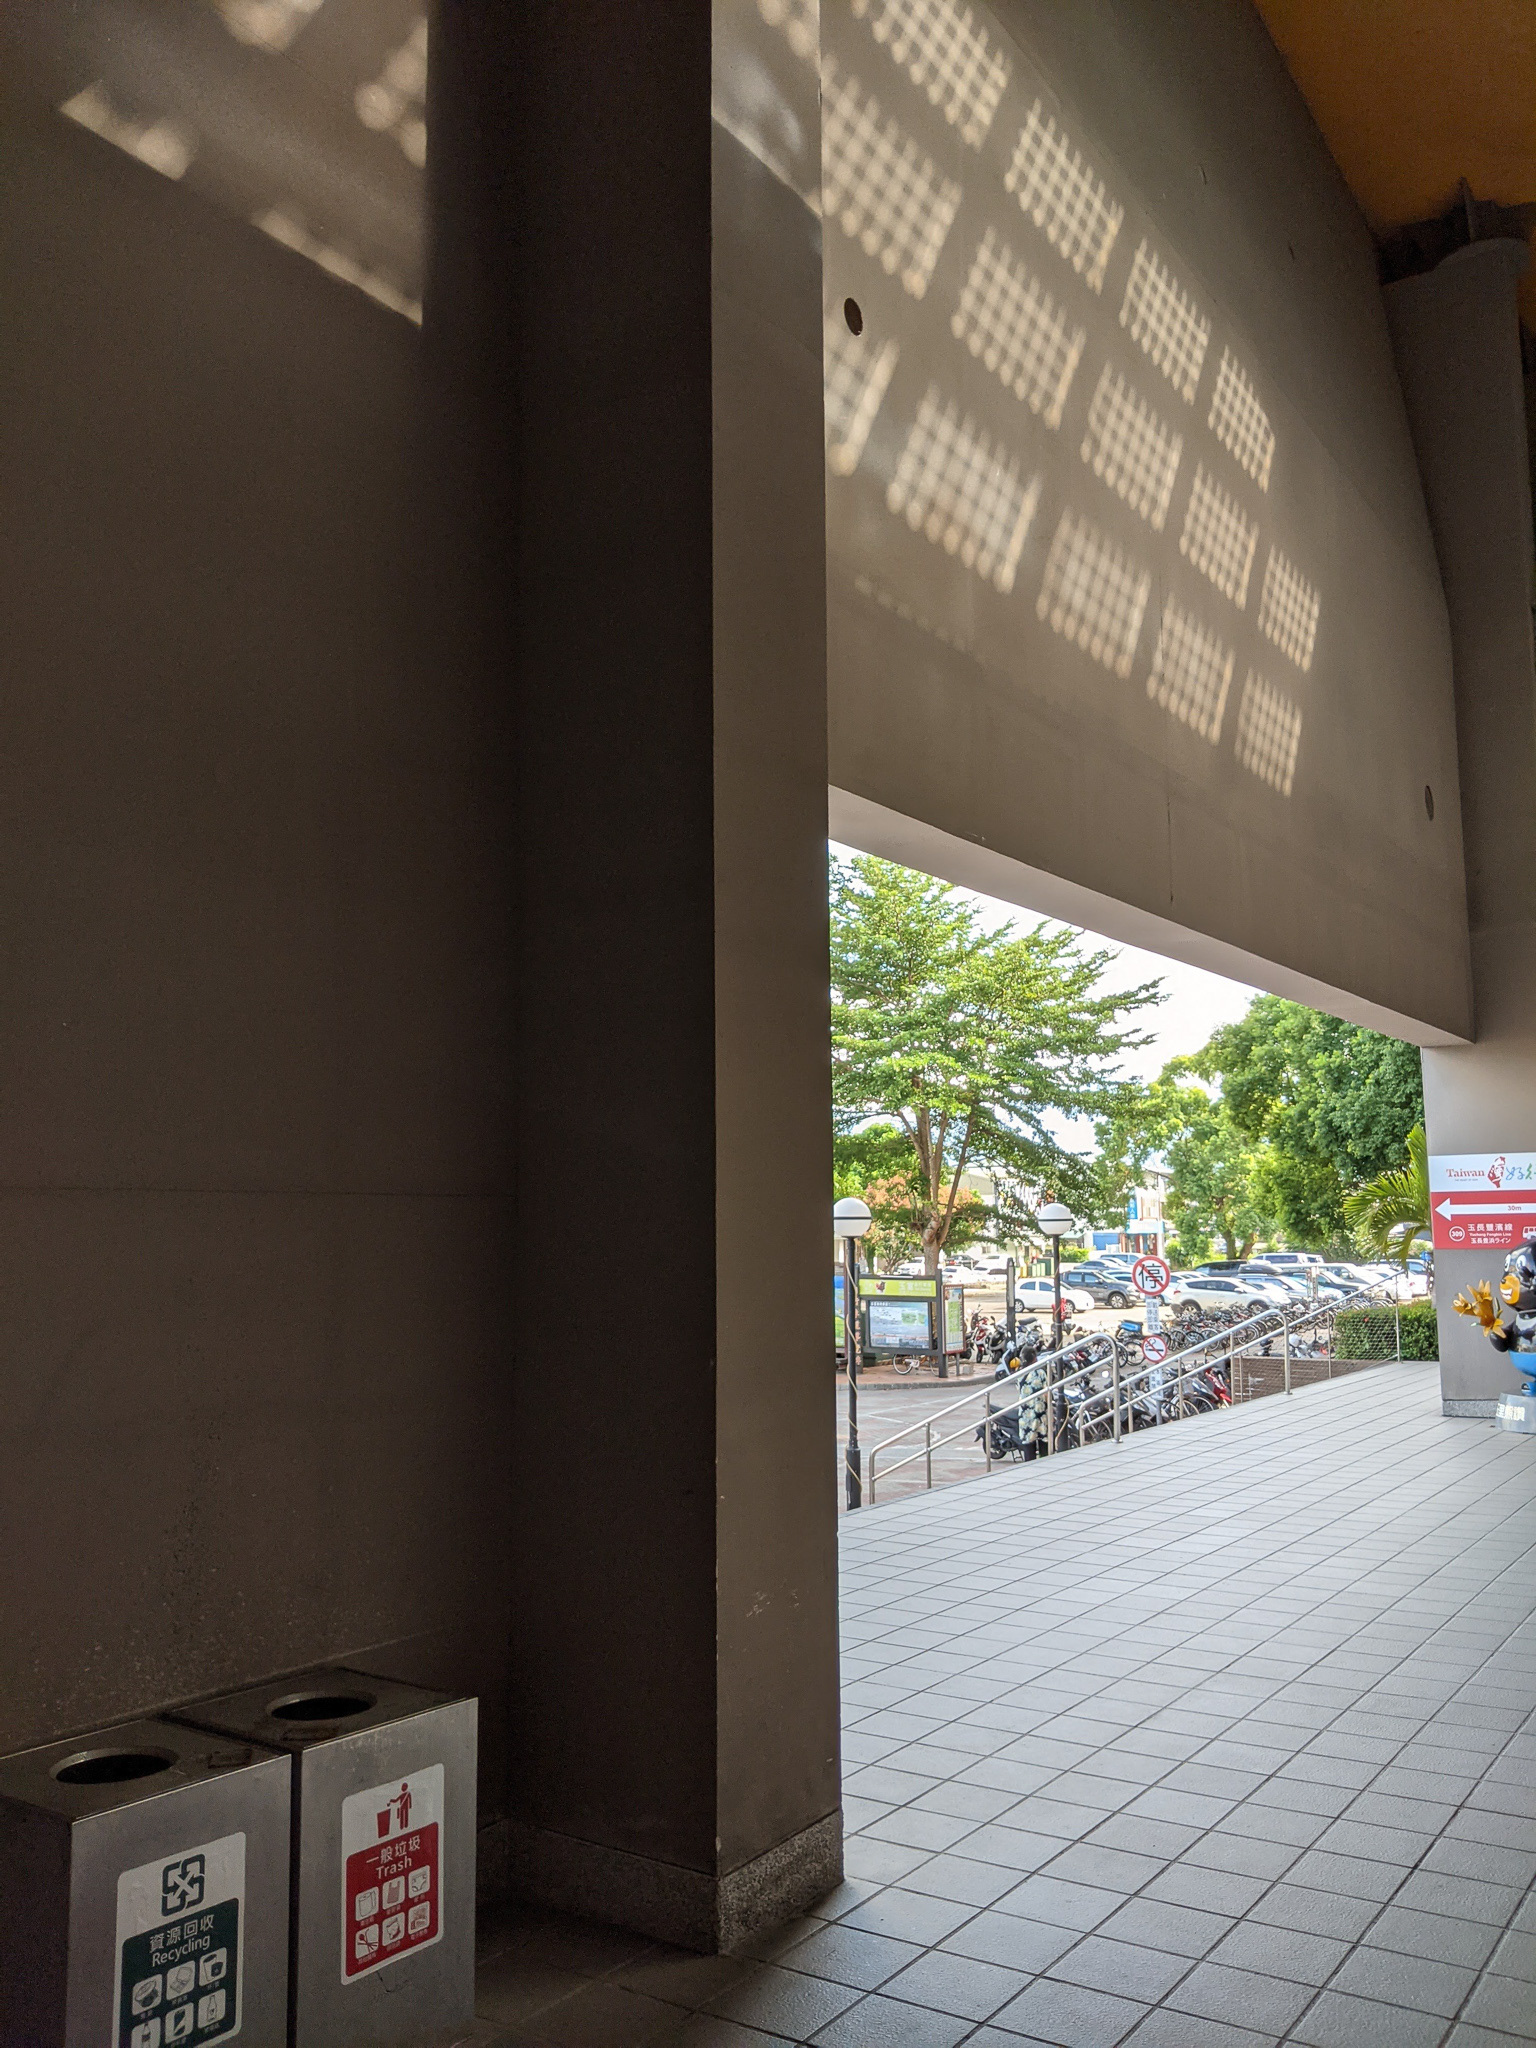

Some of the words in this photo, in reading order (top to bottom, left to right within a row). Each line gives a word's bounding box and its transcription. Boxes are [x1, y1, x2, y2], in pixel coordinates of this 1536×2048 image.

[1446, 1169, 1485, 1178] Taiwan
[1138, 1263, 1164, 1289] 停
[366, 1835, 421, 1865] 一般垃圾
[375, 1855, 412, 1880] Trash
[149, 1914, 215, 1952] 資源回收
[152, 1935, 211, 1968] Recycling
